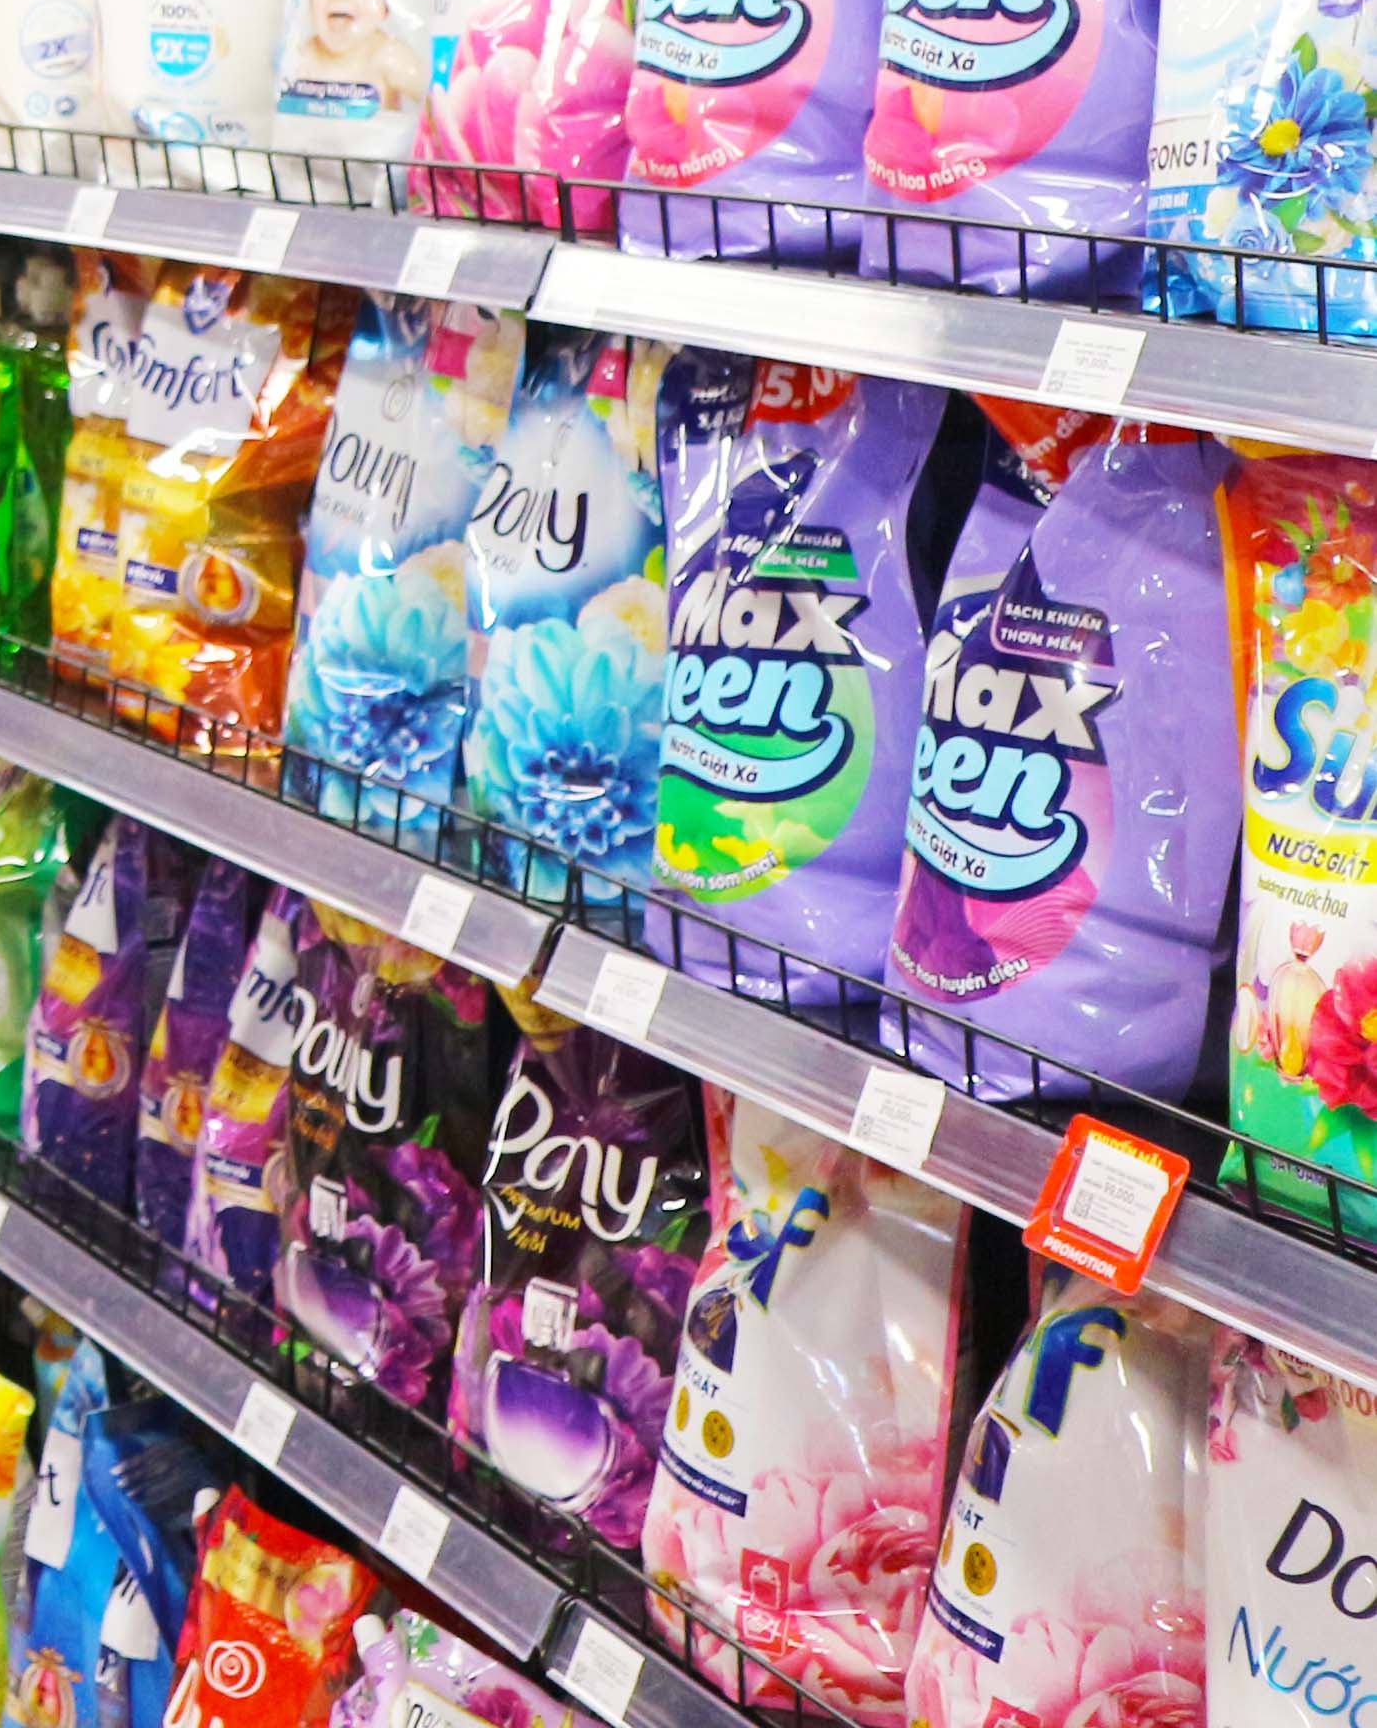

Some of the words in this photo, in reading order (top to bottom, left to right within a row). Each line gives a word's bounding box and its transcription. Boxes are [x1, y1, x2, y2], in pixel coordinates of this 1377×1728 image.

[670, 568, 865, 656] Max
[1005, 603, 1045, 621] SẠCH
[1046, 608, 1103, 632] KHUẨN
[1000, 627, 1044, 647] THƠM
[1046, 635, 1084, 653] MỀM
[1043, 1236, 1117, 1278] PROMOTION
